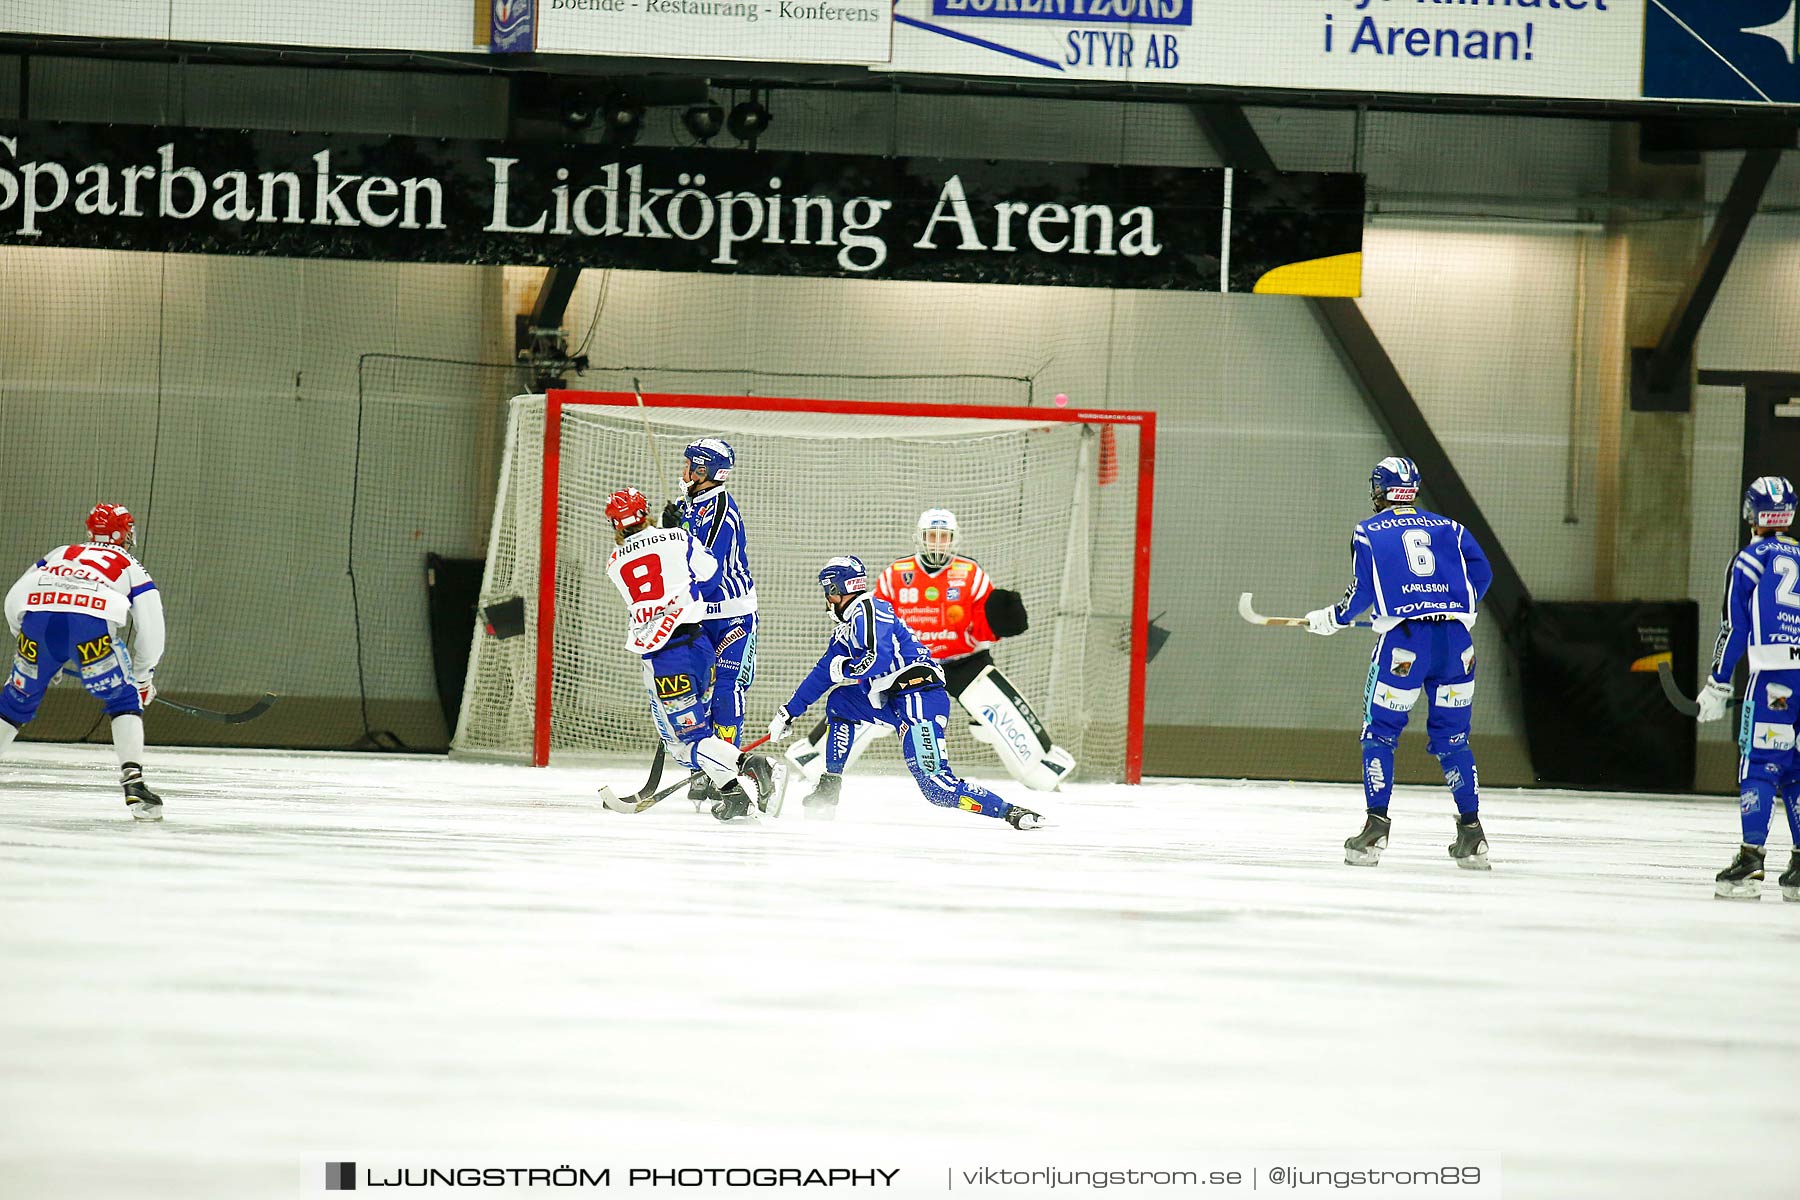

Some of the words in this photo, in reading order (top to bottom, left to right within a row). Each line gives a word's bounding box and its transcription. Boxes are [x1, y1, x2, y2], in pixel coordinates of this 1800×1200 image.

[778, 1, 879, 22] Konferens
[1065, 30, 1134, 67] STYR
[1145, 34, 1179, 69] AB
[1325, 14, 1332, 52] i
[1350, 16, 1533, 61] Arenan!
[0, 135, 446, 237] Sparbanken
[482, 157, 893, 271] Lidköping
[914, 174, 1163, 257] Arena
[618, 534, 667, 557] HURTIGS
[1402, 529, 1436, 577] 6
[620, 553, 665, 604] 8
[1402, 584, 1449, 593] KARLSSON
[1772, 555, 1800, 609] 2
[29, 593, 105, 609] CRAMO
[706, 603, 722, 614] bil
[1394, 601, 1447, 614] TOVEKS
[655, 674, 691, 694] YVS
[921, 726, 934, 750] data
[1001, 711, 1031, 761] ViaCon
